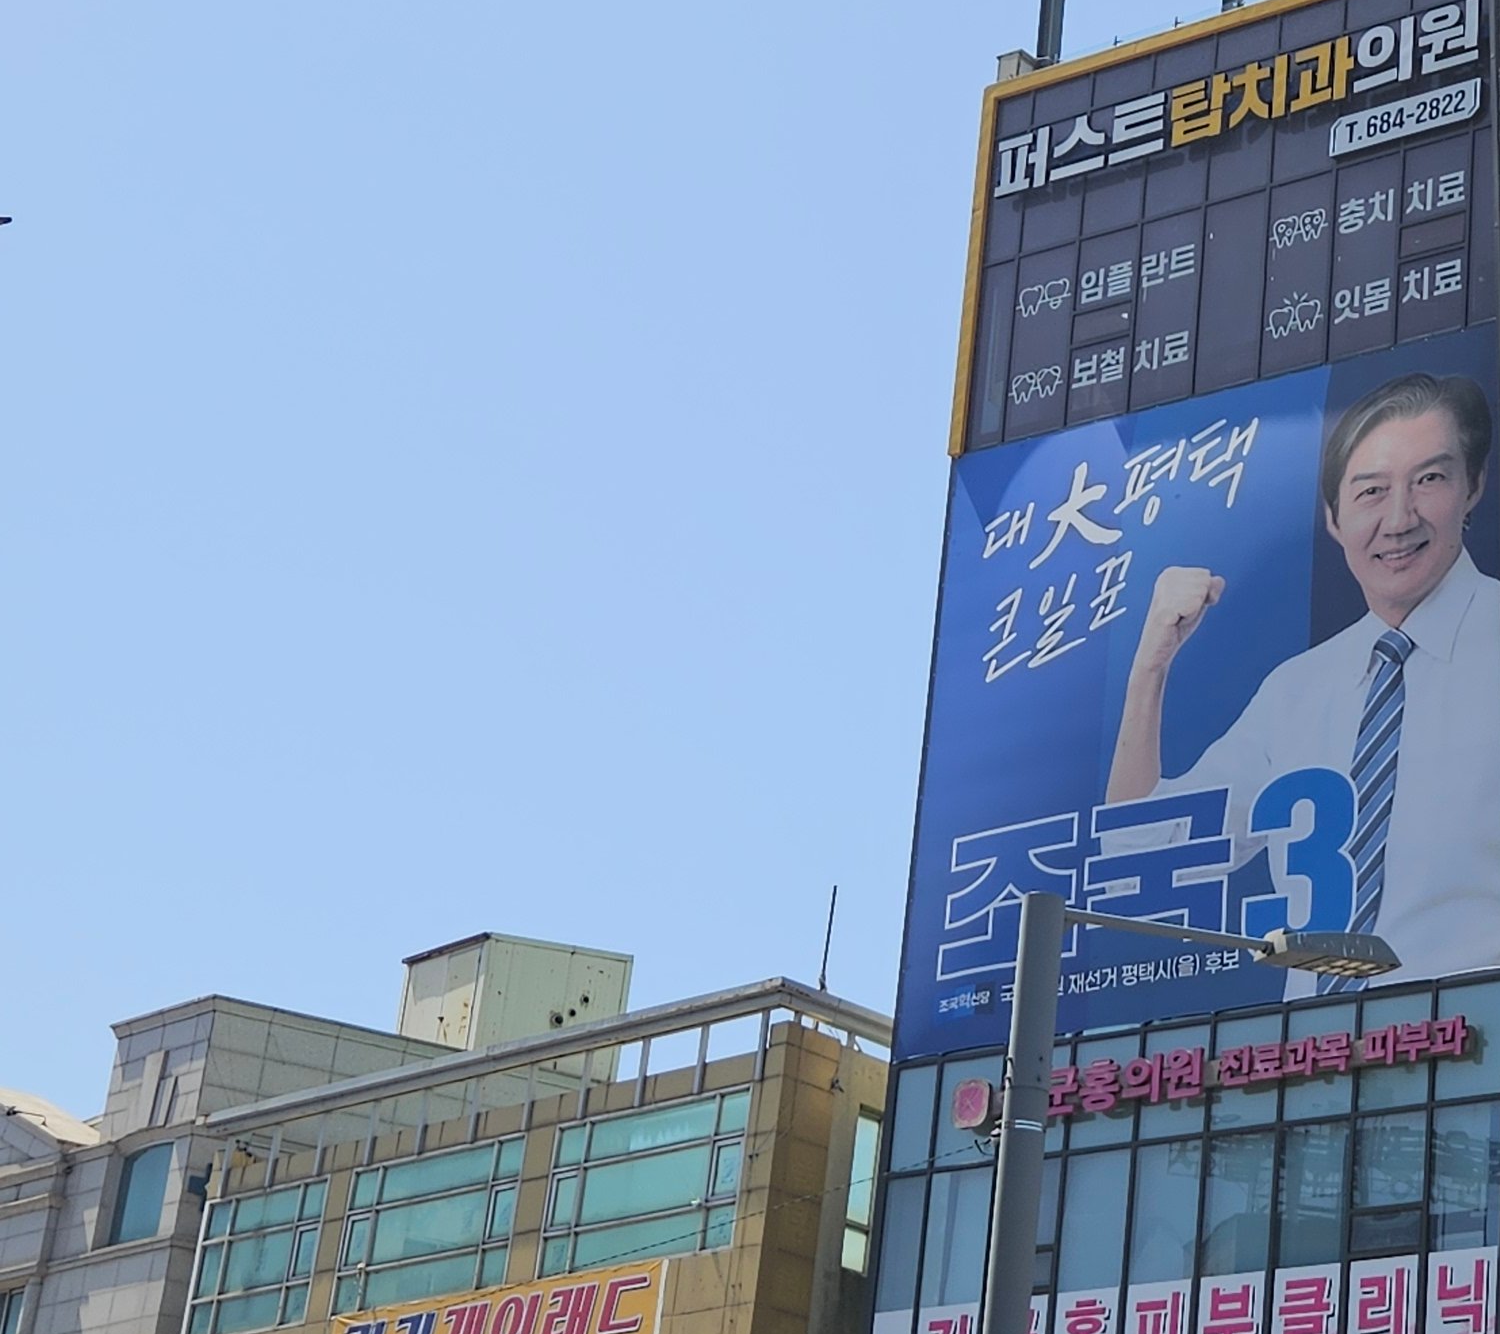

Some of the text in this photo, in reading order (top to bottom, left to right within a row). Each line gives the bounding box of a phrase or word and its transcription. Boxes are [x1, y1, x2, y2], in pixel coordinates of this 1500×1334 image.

[1344, 89, 1468, 144] T.684-2822
[1337, 170, 1466, 236] 충치 치료
[1080, 243, 1196, 305] 임플란트
[1333, 259, 1463, 326] 잇몸 치료
[1071, 331, 1190, 391] 보철 치료
[935, 765, 1360, 982] 조국 3
[938, 990, 991, 1014] 조국혁신당
[1067, 967, 1118, 995] 재선거
[1121, 953, 1201, 987] 평택시(을)
[1204, 948, 1240, 975] 후보
[1048, 1015, 1469, 1117] 군홍의원 진료과목 피부과
